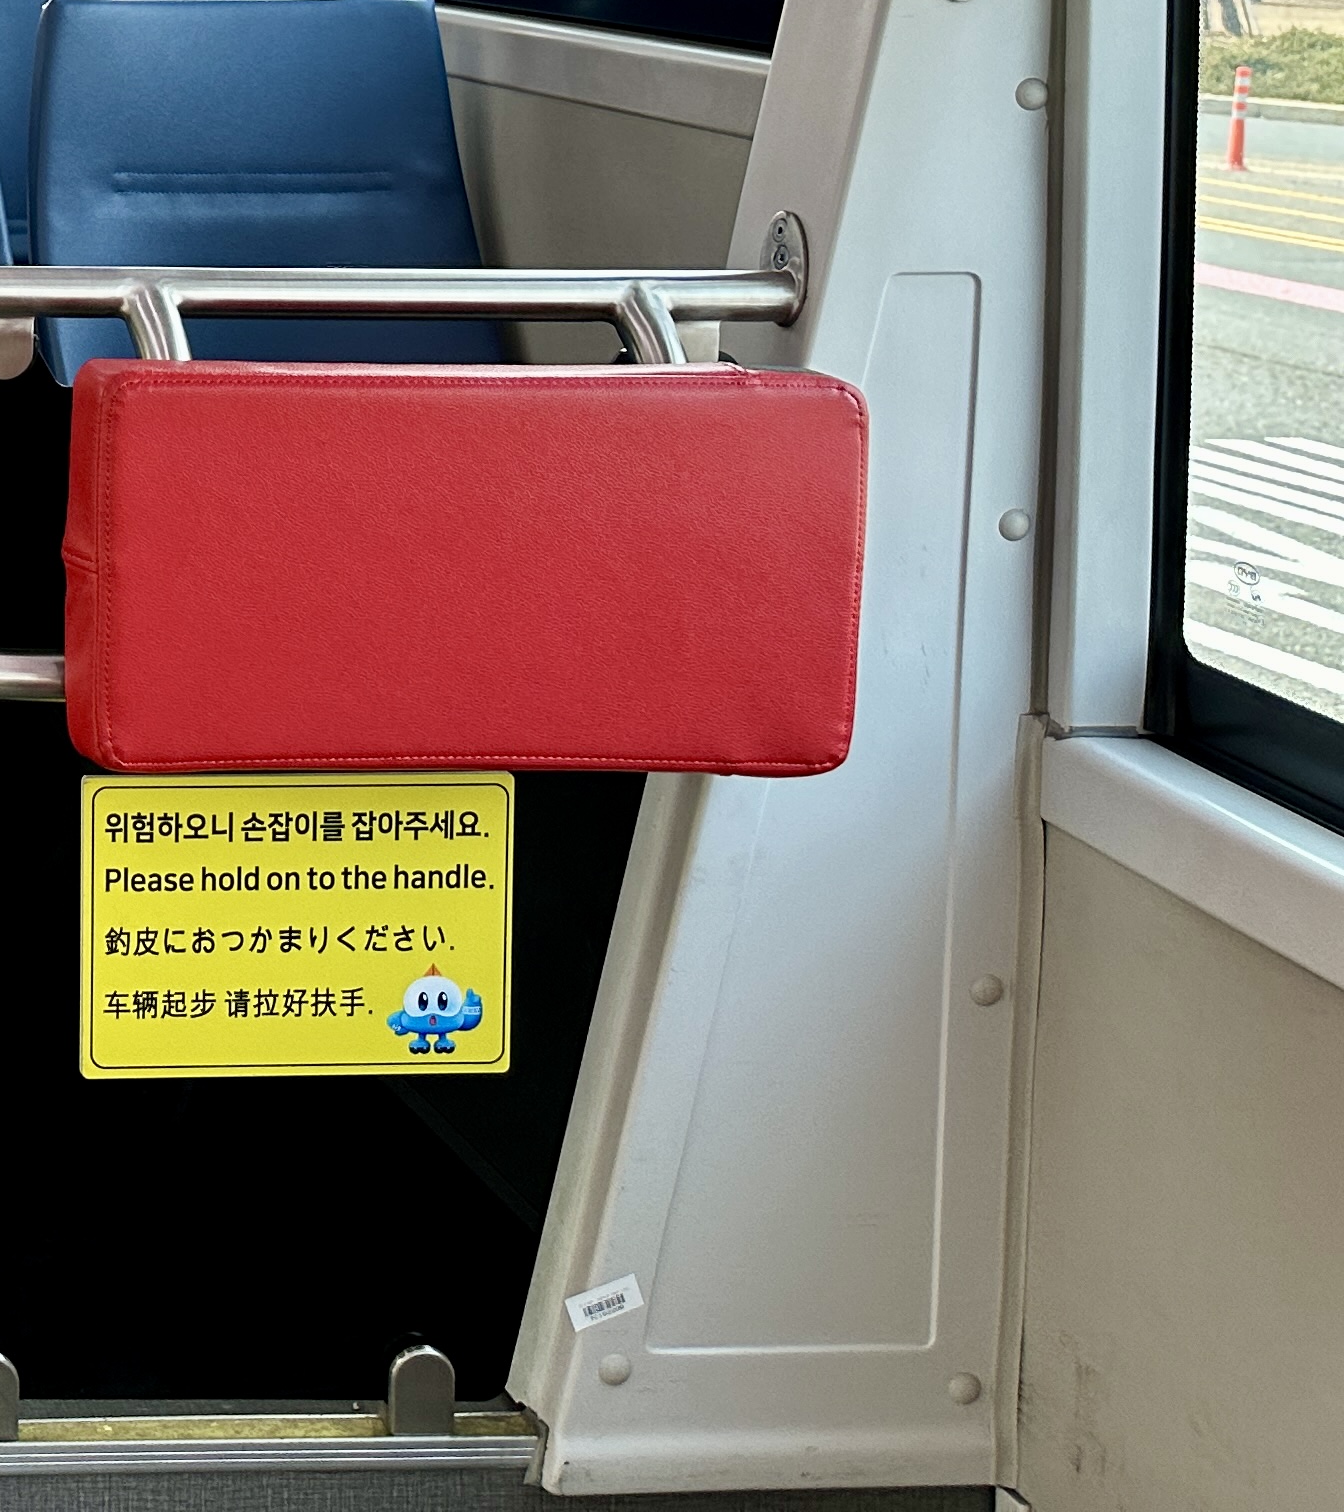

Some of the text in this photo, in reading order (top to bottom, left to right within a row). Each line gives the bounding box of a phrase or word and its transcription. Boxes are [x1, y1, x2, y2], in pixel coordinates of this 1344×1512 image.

[103, 809, 490, 844] 위험하오니 손잡이를 잡아주세요.
[104, 864, 495, 893] Please hold on to the handle.
[102, 987, 374, 1020] 车辆起步 请拉好扶手.
